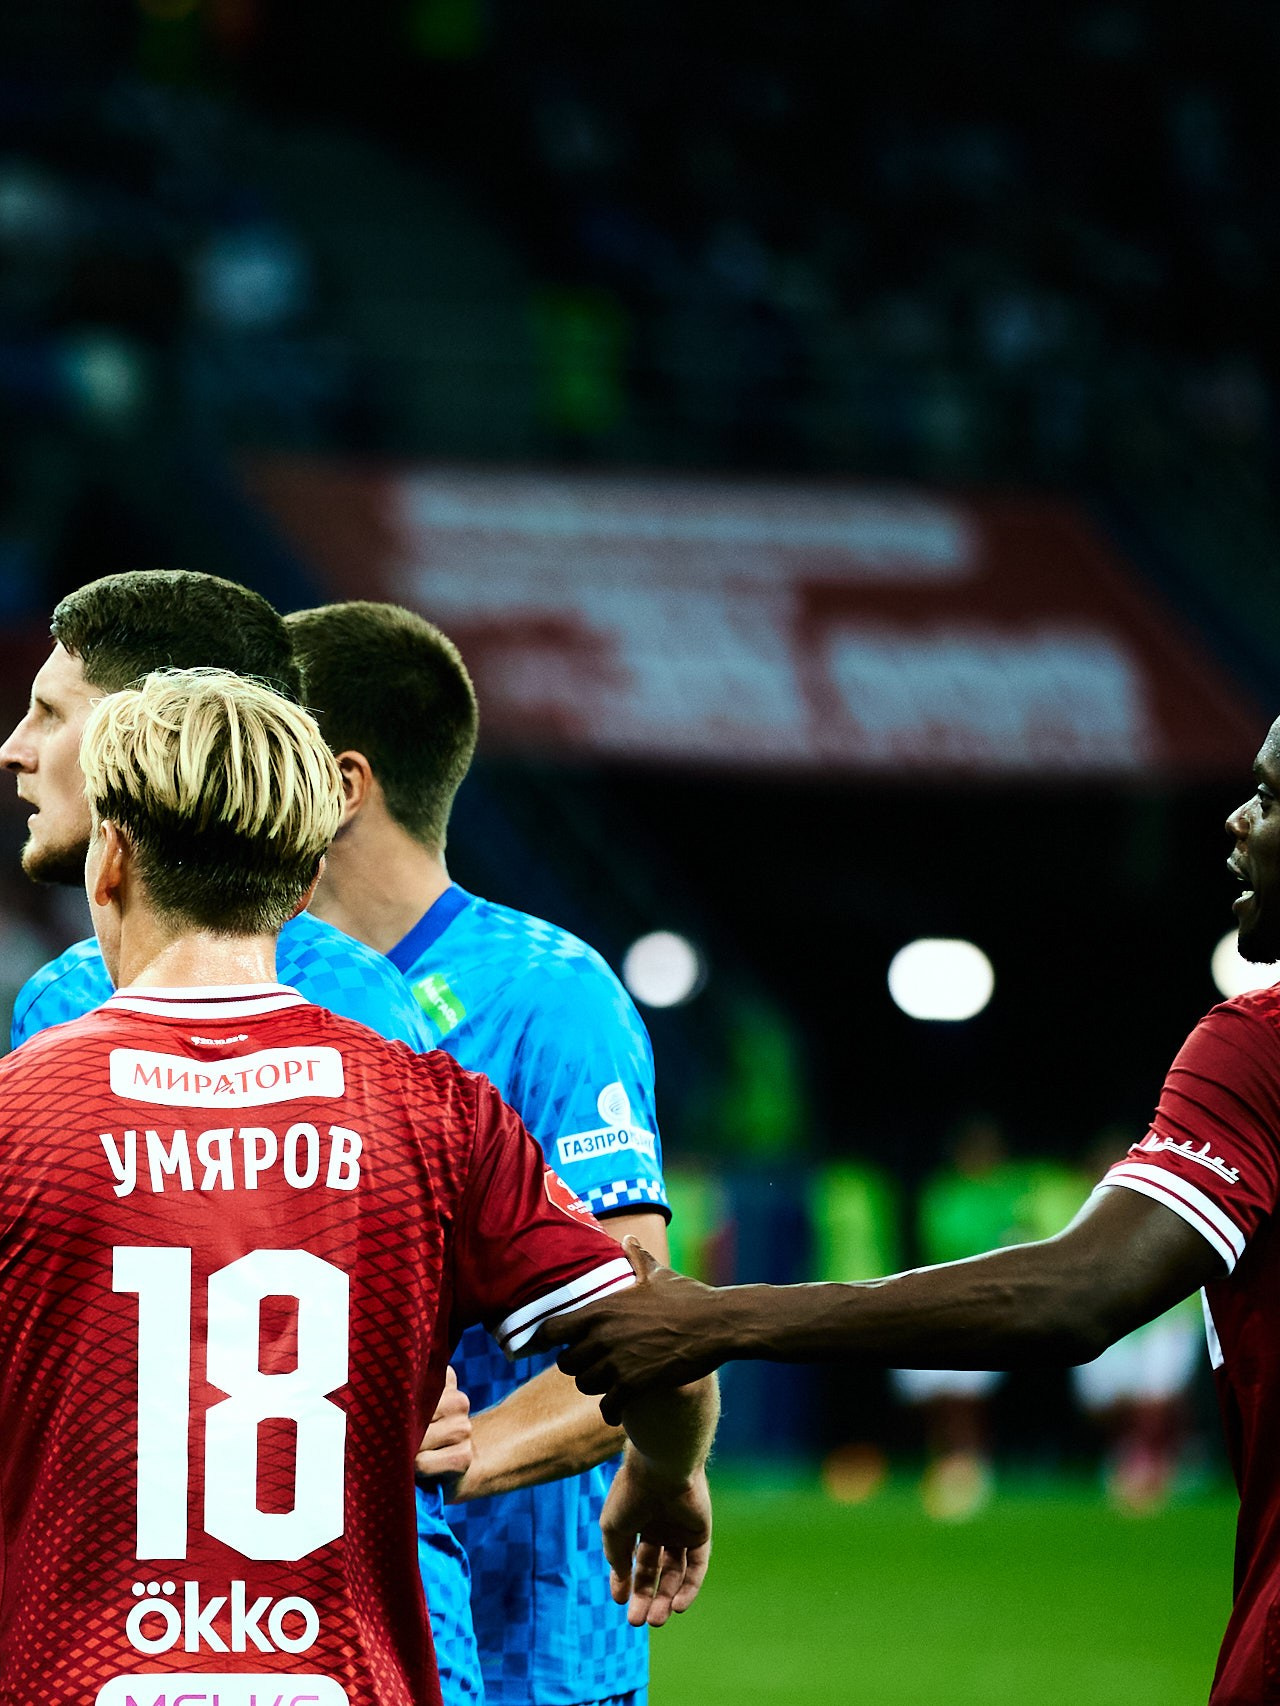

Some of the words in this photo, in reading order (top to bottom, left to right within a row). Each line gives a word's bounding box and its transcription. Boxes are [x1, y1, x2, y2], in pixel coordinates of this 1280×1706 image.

[133, 1060, 321, 1096] МИРАТОРГ
[99, 1122, 363, 1198] УМЯРОВ
[563, 1129, 650, 1157] ГАЗПРО
[112, 1246, 350, 1562] 18
